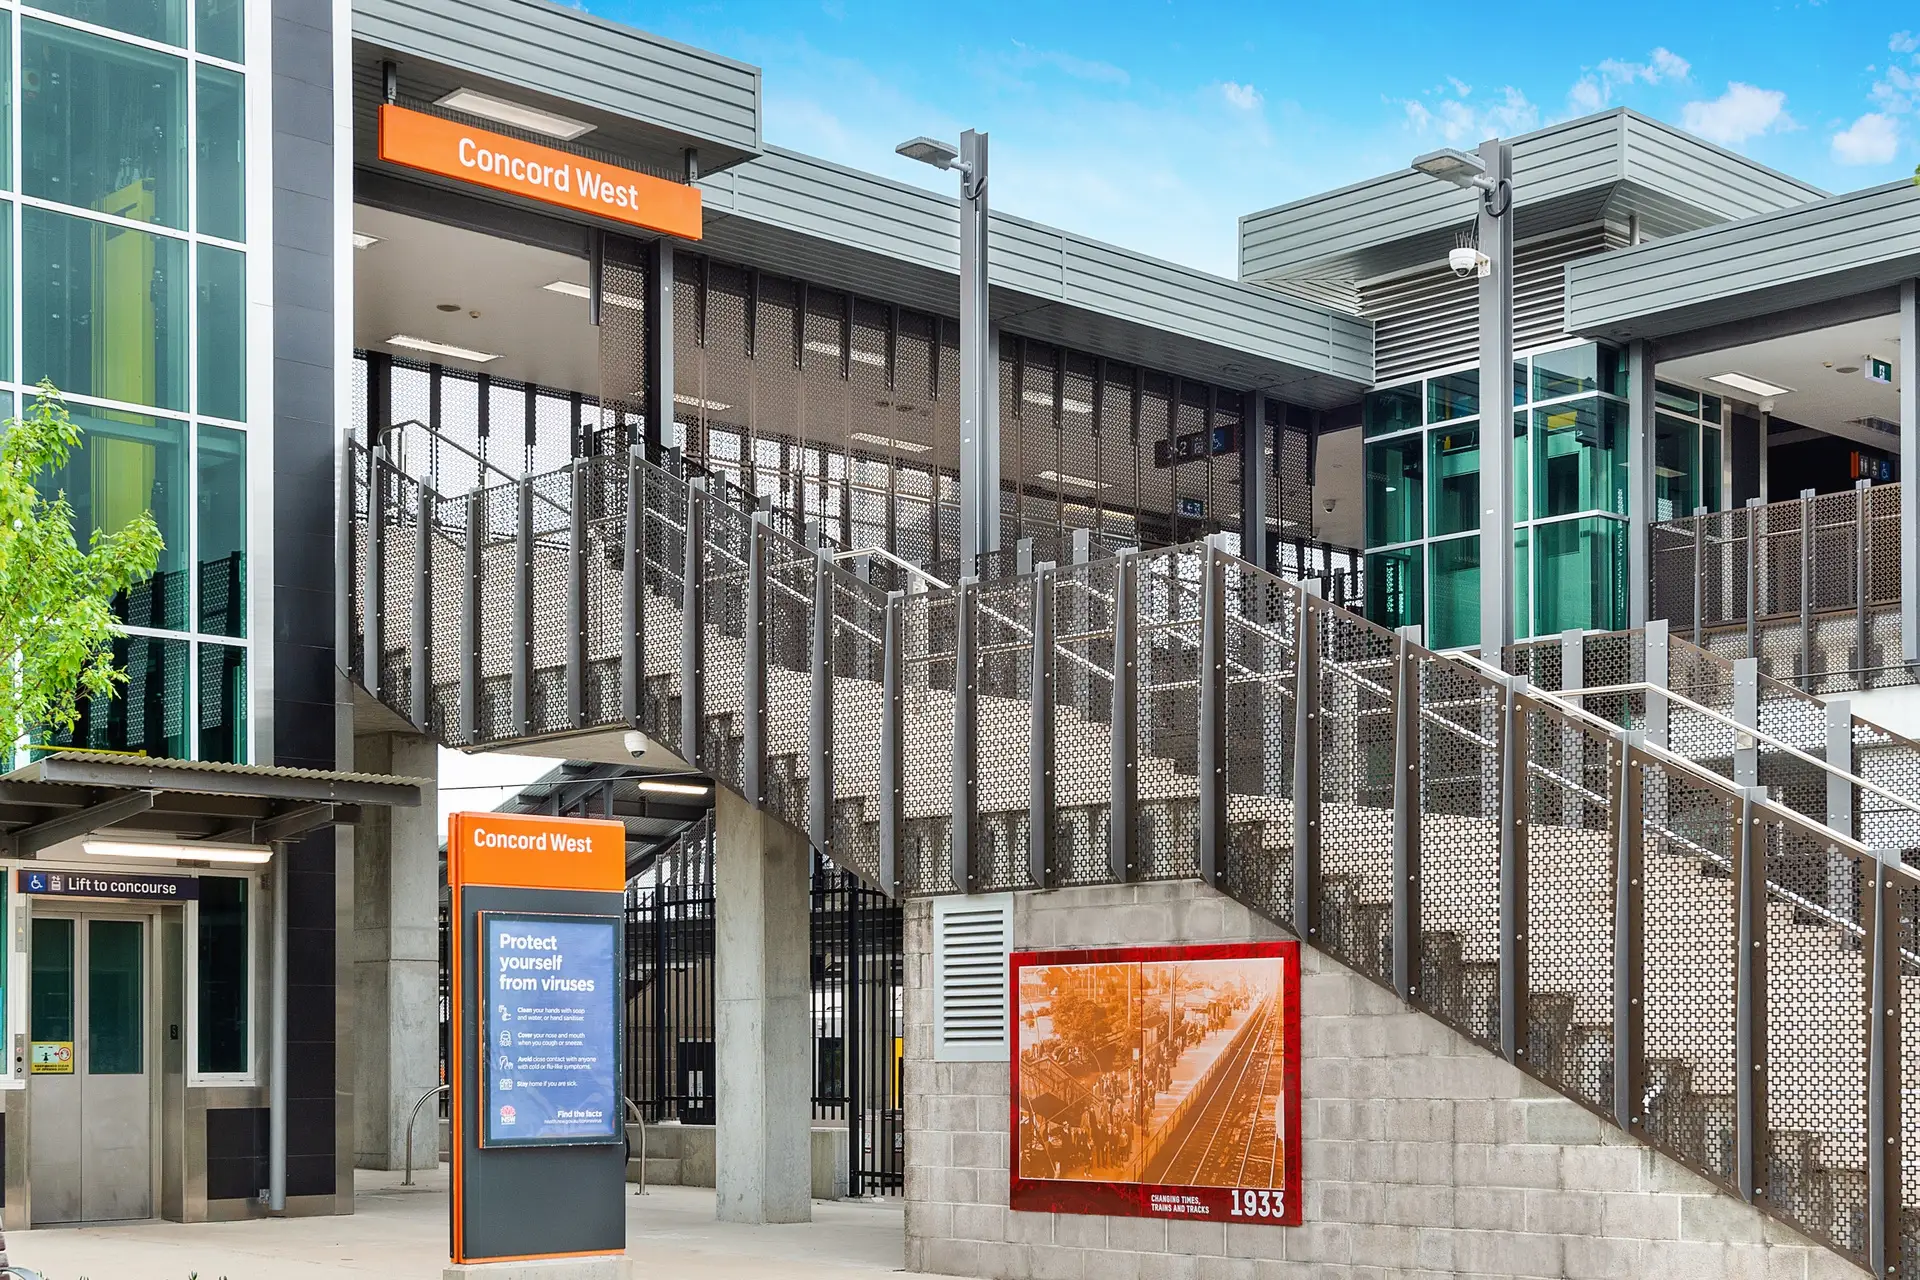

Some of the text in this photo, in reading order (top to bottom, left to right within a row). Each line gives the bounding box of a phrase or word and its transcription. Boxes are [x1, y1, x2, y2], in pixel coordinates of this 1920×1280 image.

[458, 137, 639, 211] Concord West
[474, 828, 592, 853] Concord West
[68, 877, 176, 894] Lift to concourse
[500, 933, 558, 950] Protect
[500, 955, 563, 972] yourself
[499, 974, 595, 992] from viruses
[557, 1110, 602, 1118] Find the facts
[1151, 1194, 1201, 1205] CHANGING TIMES,
[1231, 1190, 1285, 1218] 1933
[1151, 1203, 1210, 1214] TRAINS AND TRACKS
